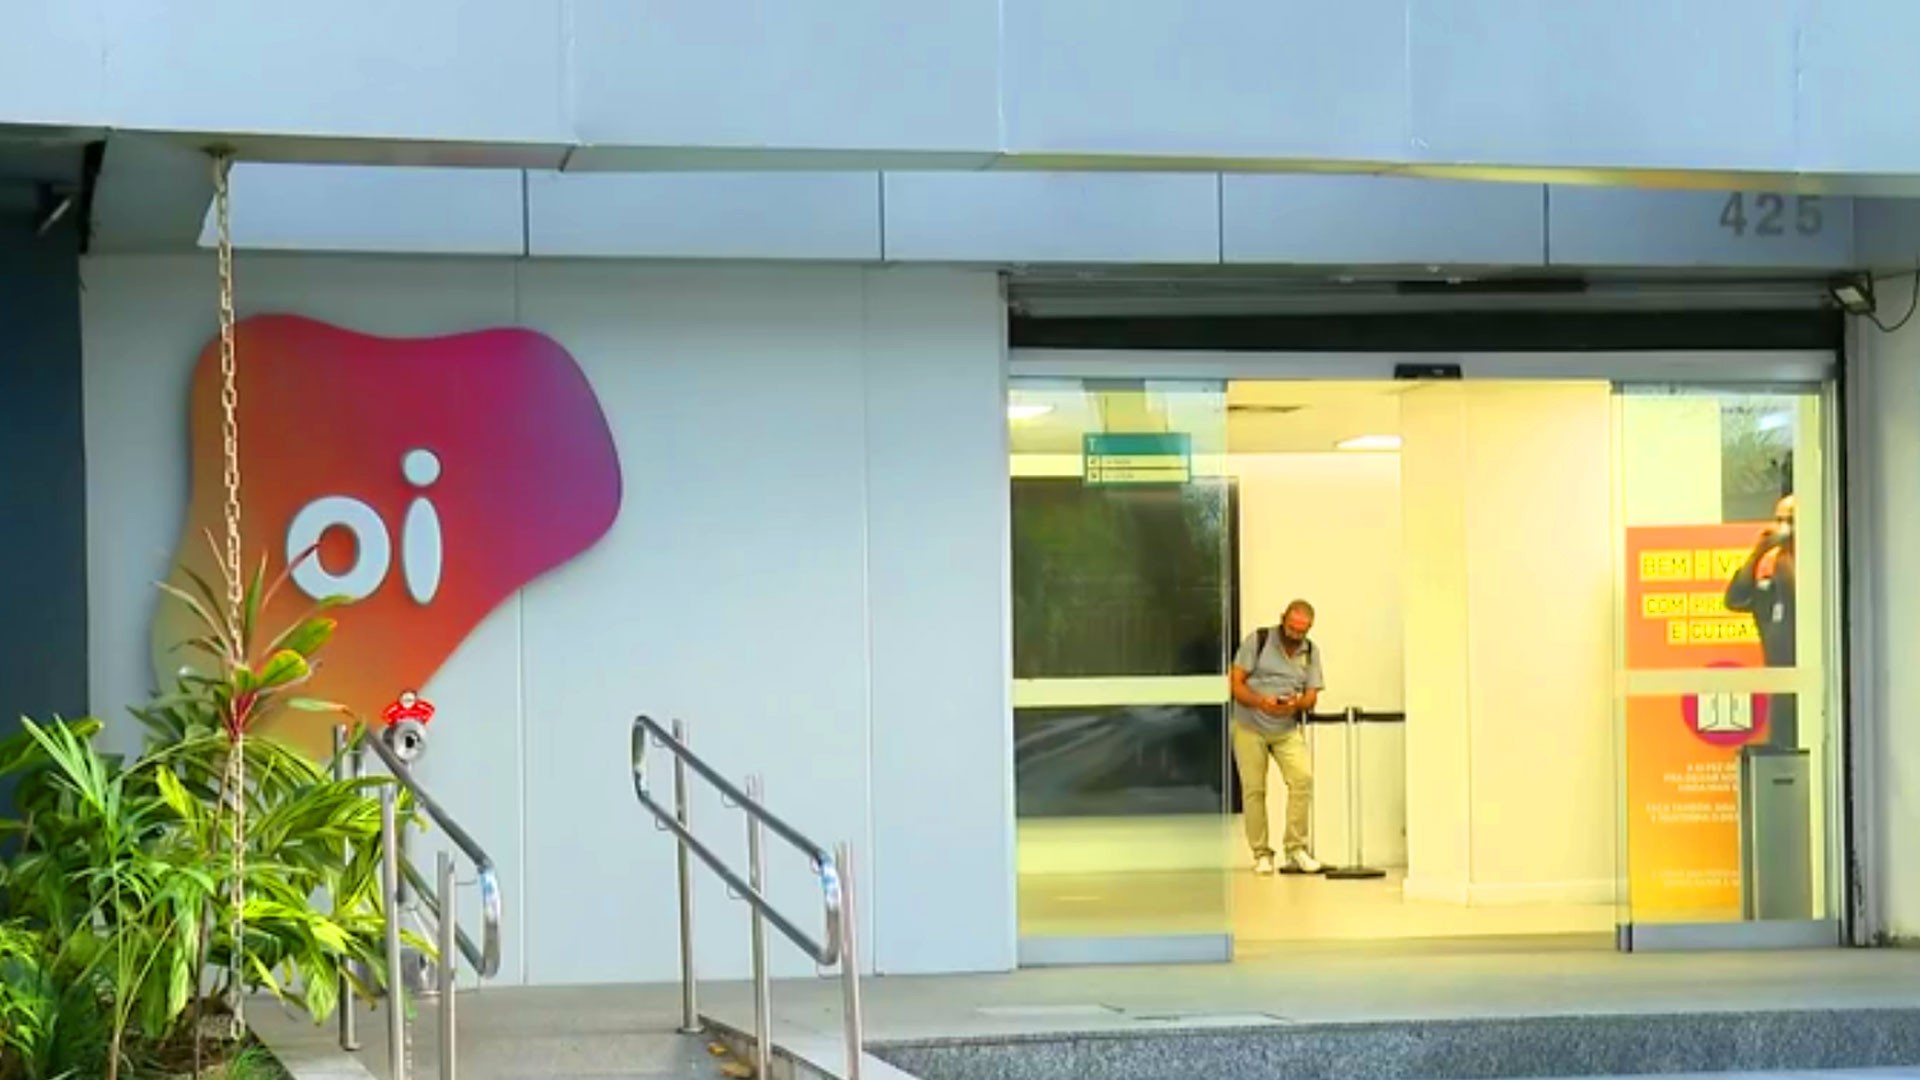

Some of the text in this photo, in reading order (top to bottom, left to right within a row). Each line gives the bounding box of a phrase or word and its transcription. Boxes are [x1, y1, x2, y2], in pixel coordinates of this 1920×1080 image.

[1719, 192, 1823, 236] 425
[286, 448, 442, 605] oi
[1646, 597, 1684, 614] COM
[1671, 623, 1682, 640] E
